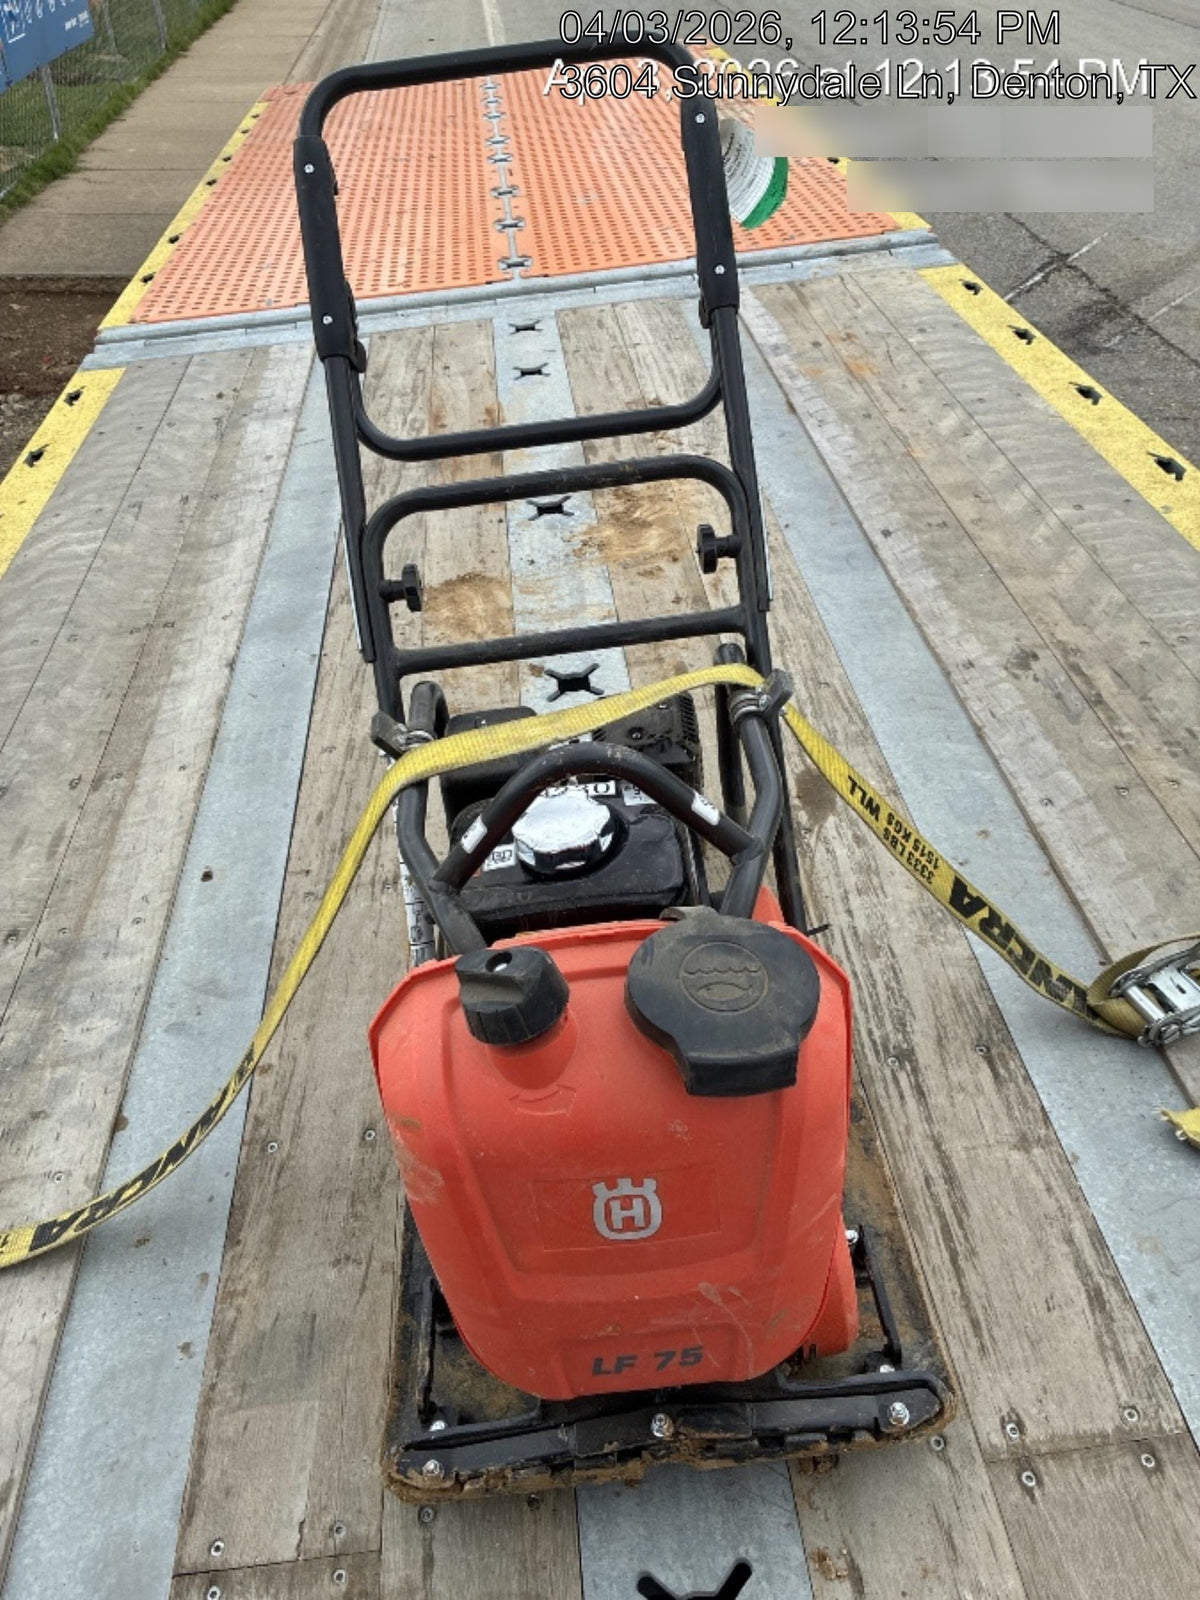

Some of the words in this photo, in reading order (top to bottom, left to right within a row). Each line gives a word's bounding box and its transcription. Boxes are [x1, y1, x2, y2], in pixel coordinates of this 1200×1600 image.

[847, 774, 881, 822] WLL
[591, 1353, 638, 1376] LF
[653, 1345, 705, 1371] 75
